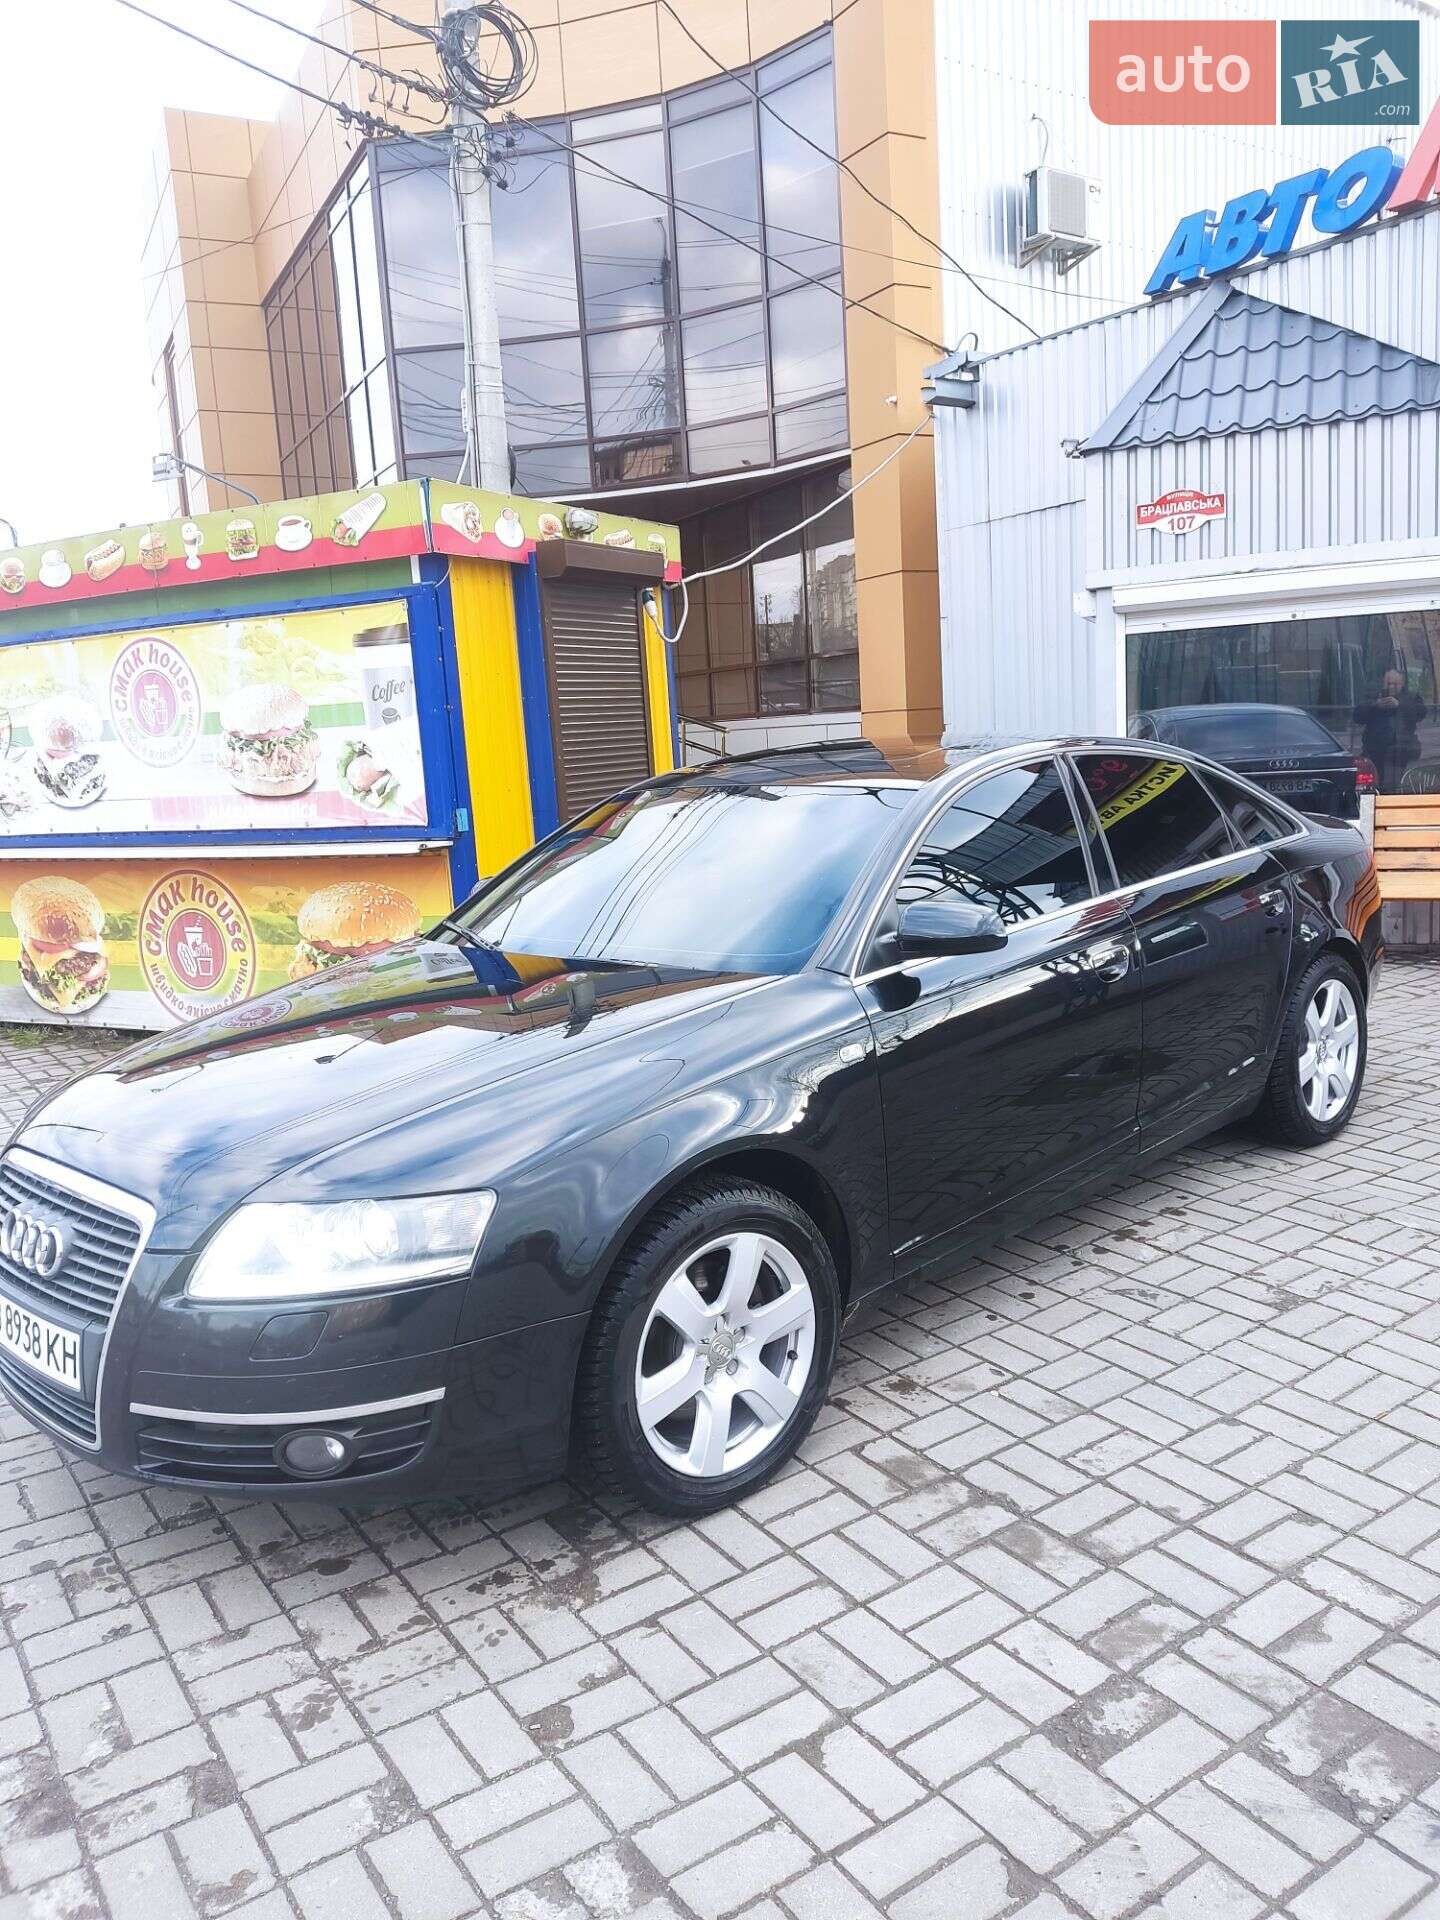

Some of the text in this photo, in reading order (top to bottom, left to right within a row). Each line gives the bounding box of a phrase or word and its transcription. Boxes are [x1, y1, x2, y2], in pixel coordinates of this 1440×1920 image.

[1140, 497, 1222, 517] БРАЦЛАВСЬКА
[1168, 515, 1196, 531] 107
[148, 643, 194, 703] house
[371, 679, 406, 704] Coffee
[190, 876, 247, 954] house
[5, 1304, 77, 1379] 8938 KH
